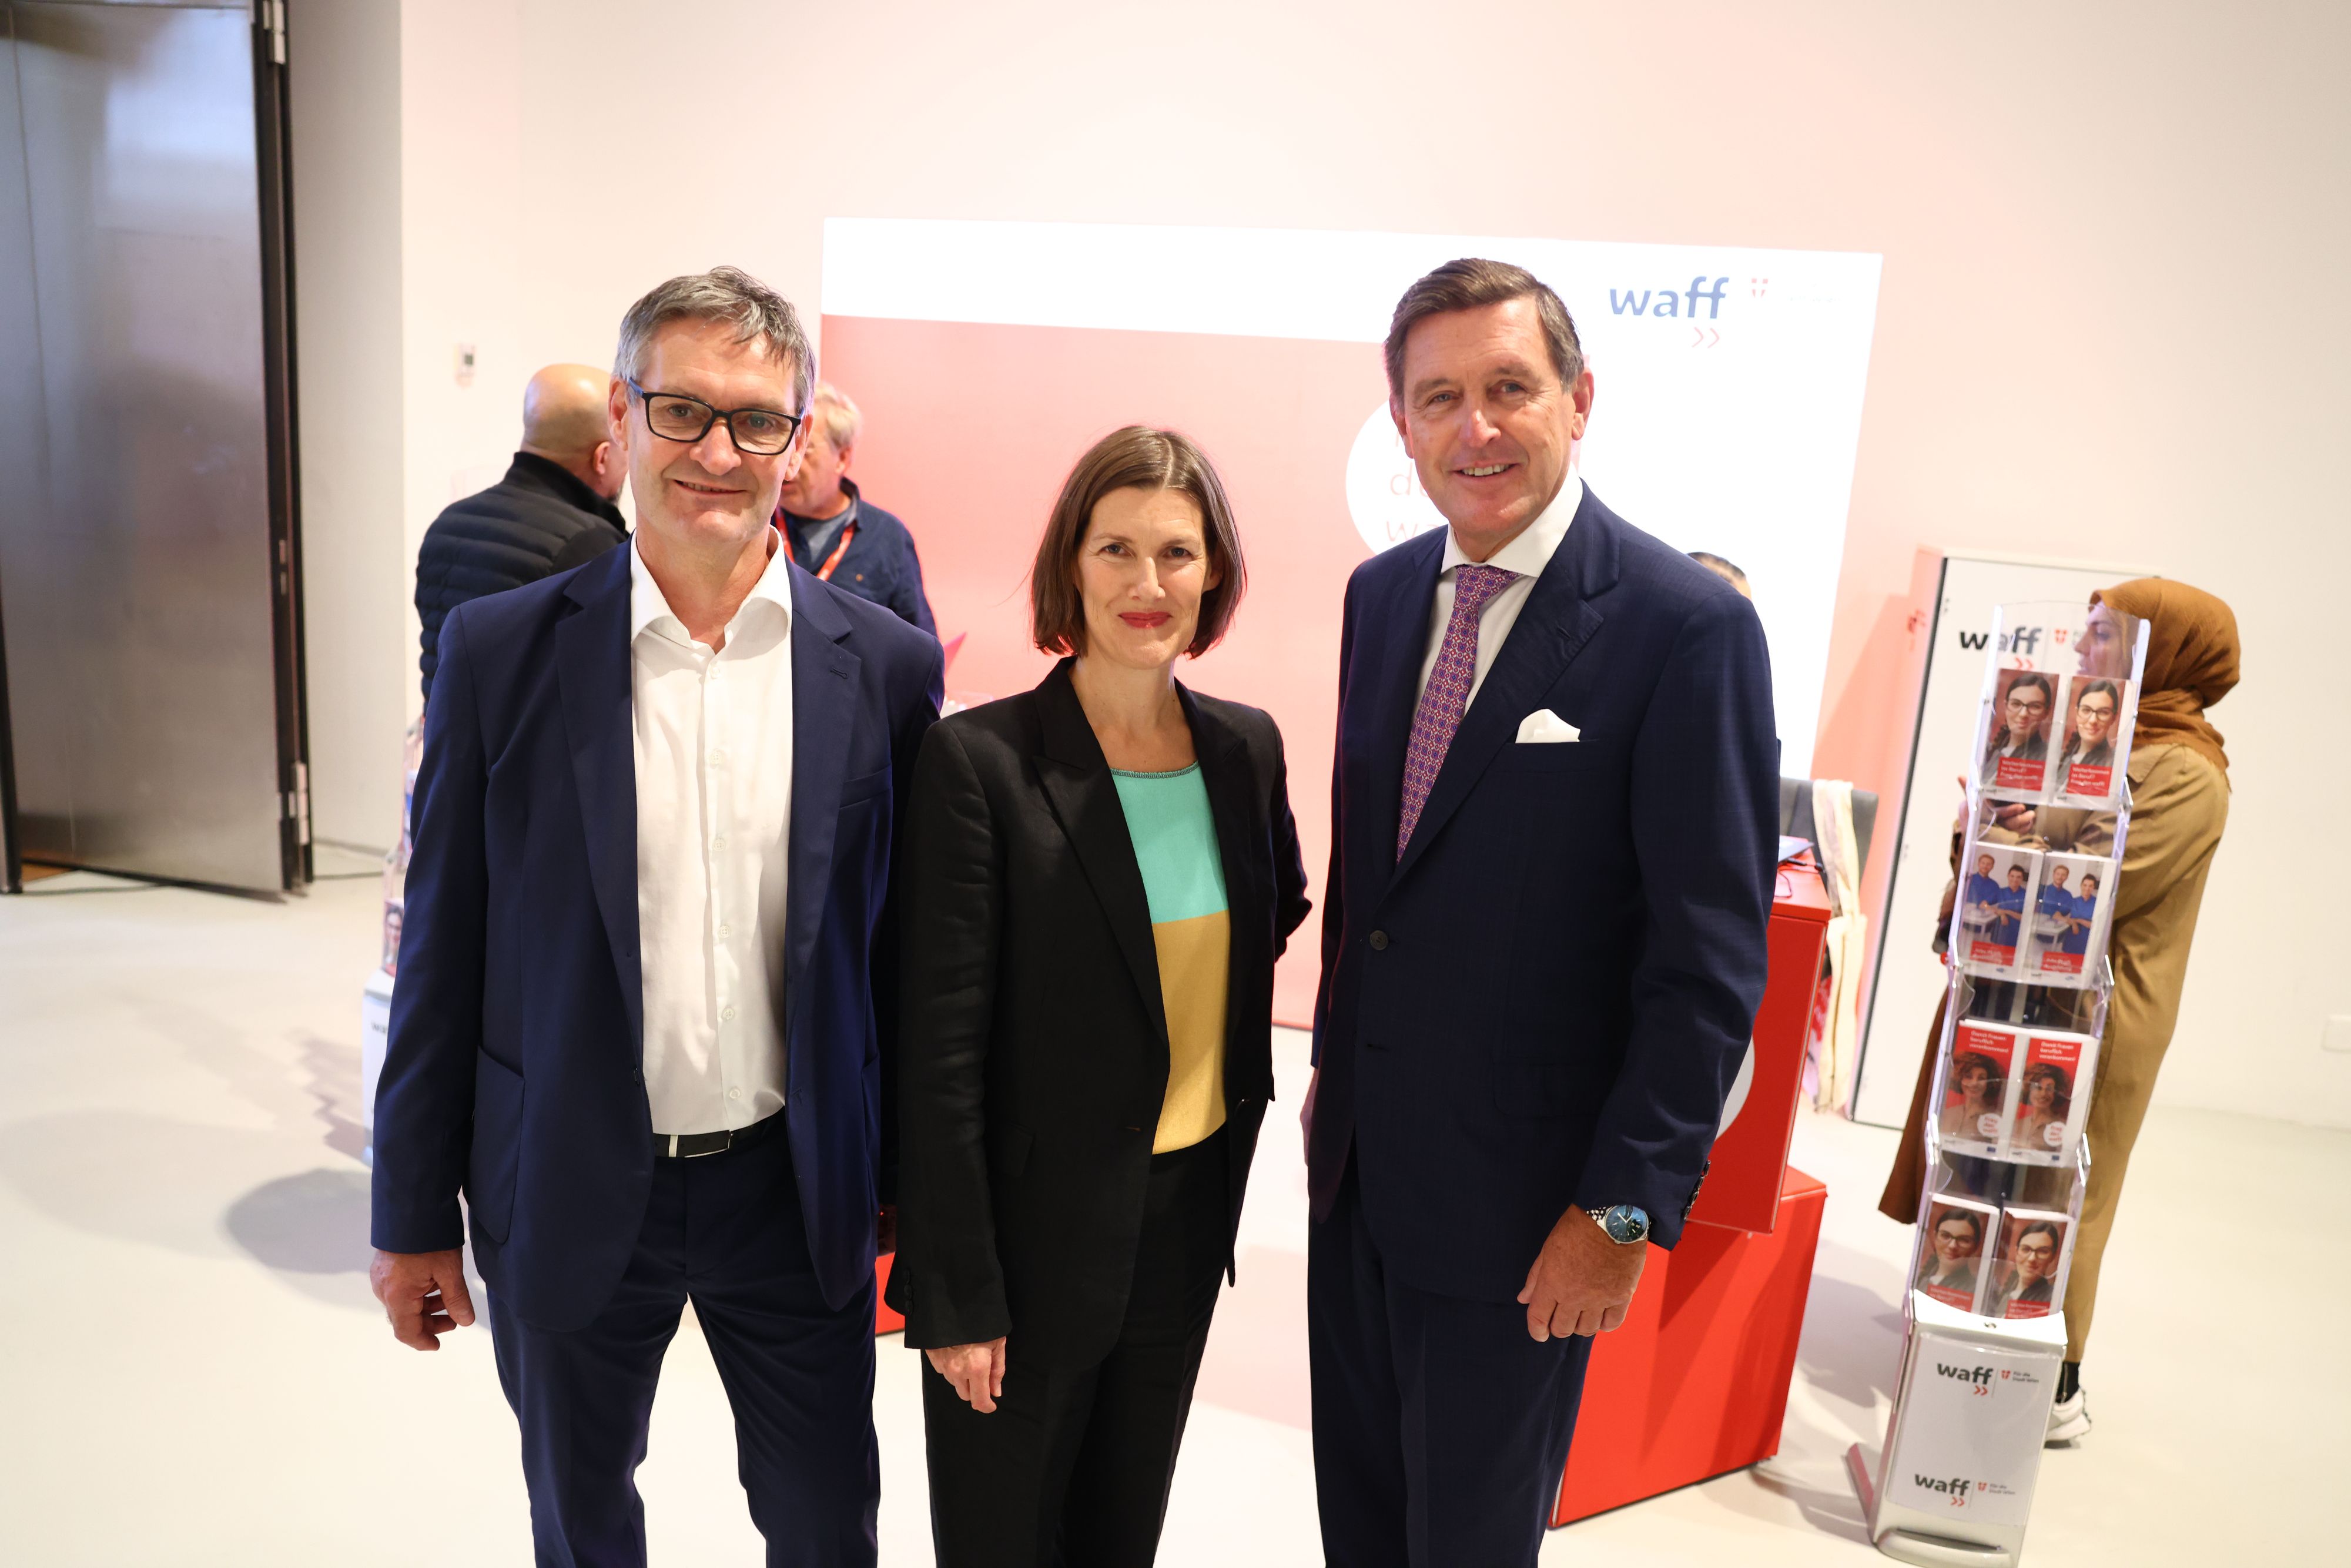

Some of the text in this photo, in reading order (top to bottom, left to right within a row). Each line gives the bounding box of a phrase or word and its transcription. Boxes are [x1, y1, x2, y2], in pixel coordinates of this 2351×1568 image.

[1610, 276, 1729, 319] waff
[1937, 1363, 1994, 1385] waff
[1915, 1473, 1970, 1496] waff
